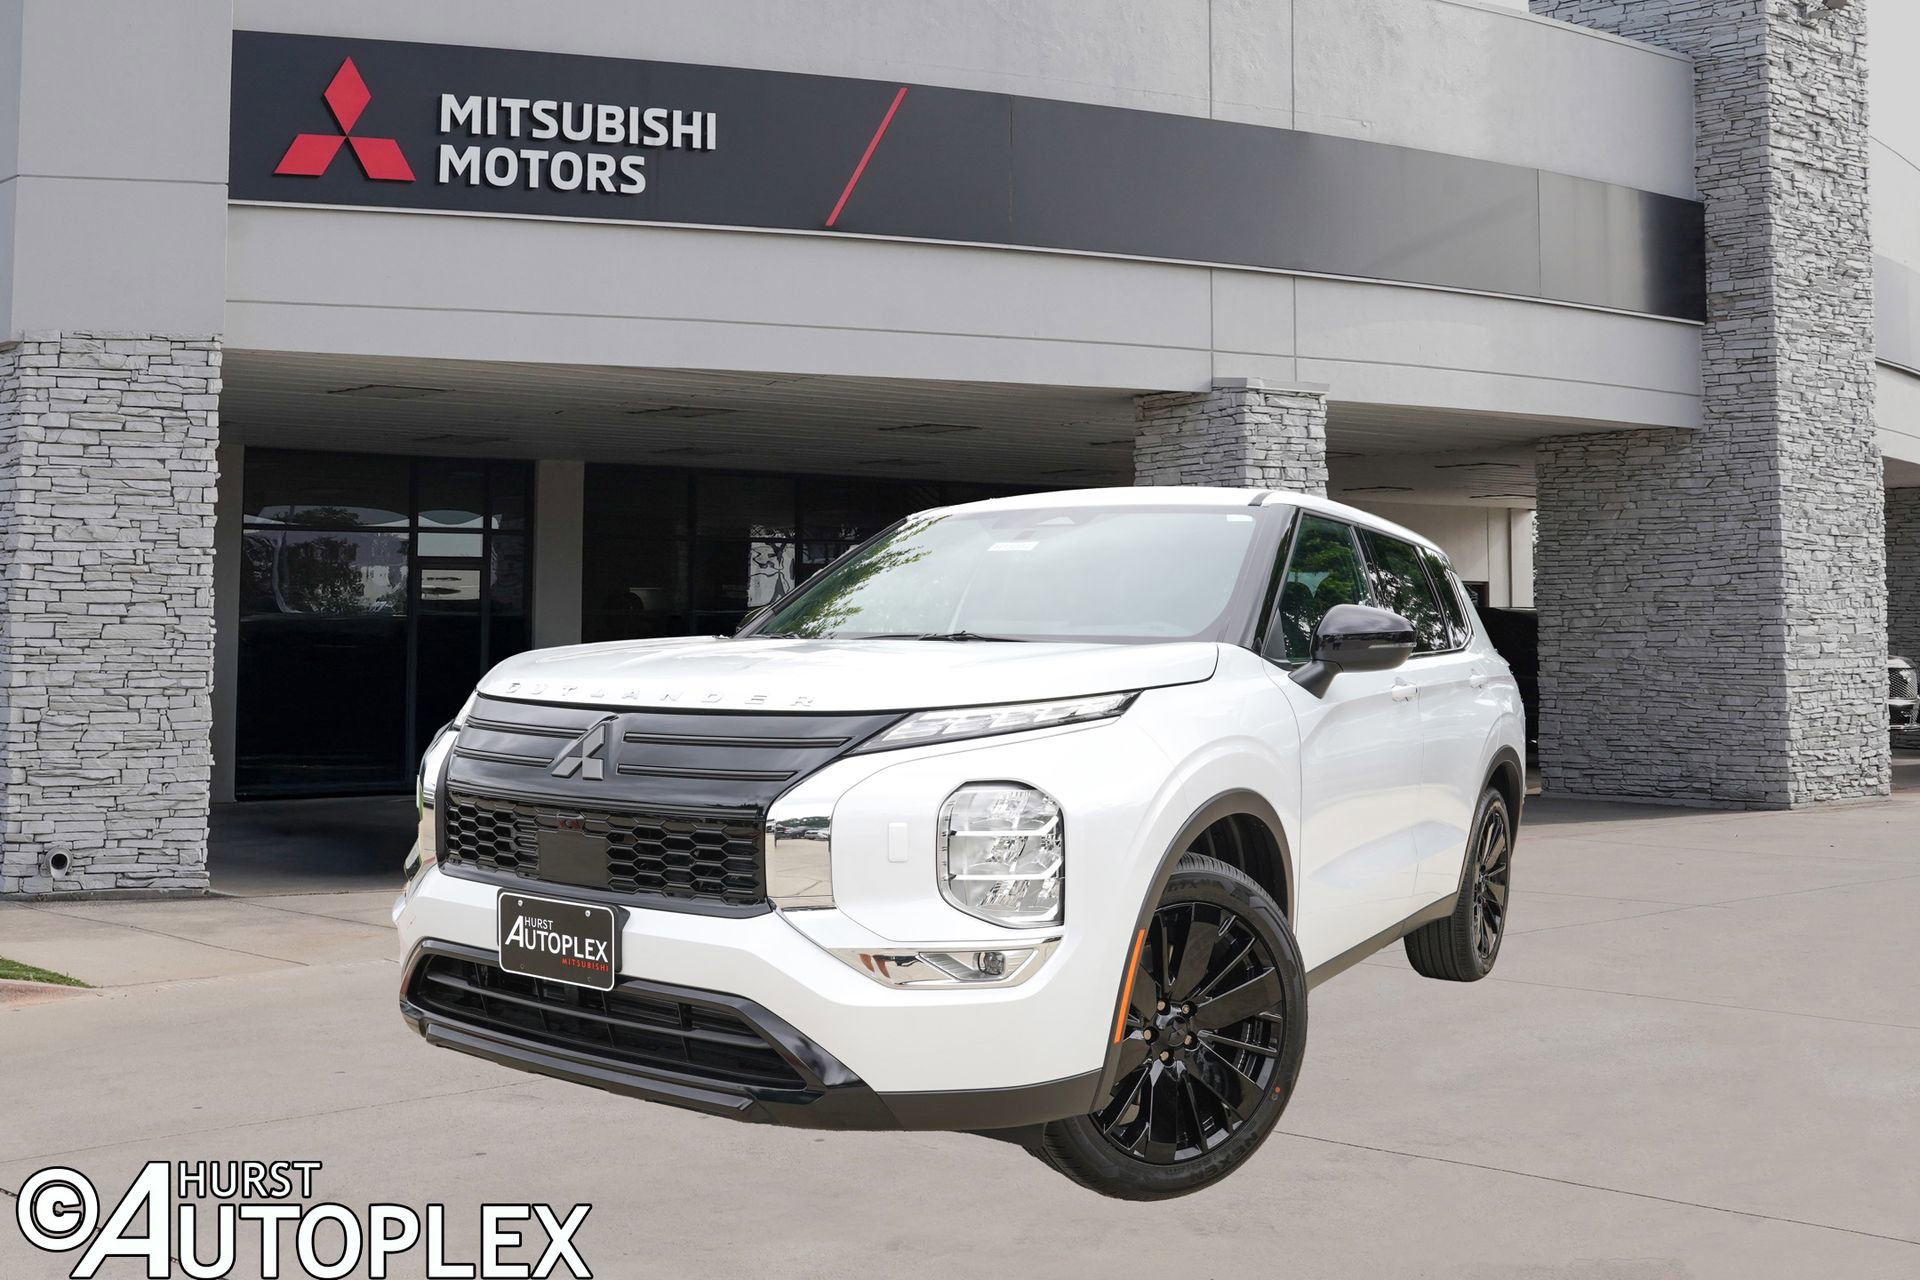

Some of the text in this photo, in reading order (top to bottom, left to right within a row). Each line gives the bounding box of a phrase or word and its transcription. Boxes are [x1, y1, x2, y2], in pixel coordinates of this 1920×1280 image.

[439, 92, 717, 151] MITSUBISHI
[437, 144, 647, 196] MOTORS
[504, 682, 815, 708] OUTLANDER
[505, 915, 608, 963] AUTOPLEX
[524, 915, 553, 931] HURST
[561, 957, 609, 972] MITSUBISHI
[1190, 1130, 1260, 1183] NEXEN
